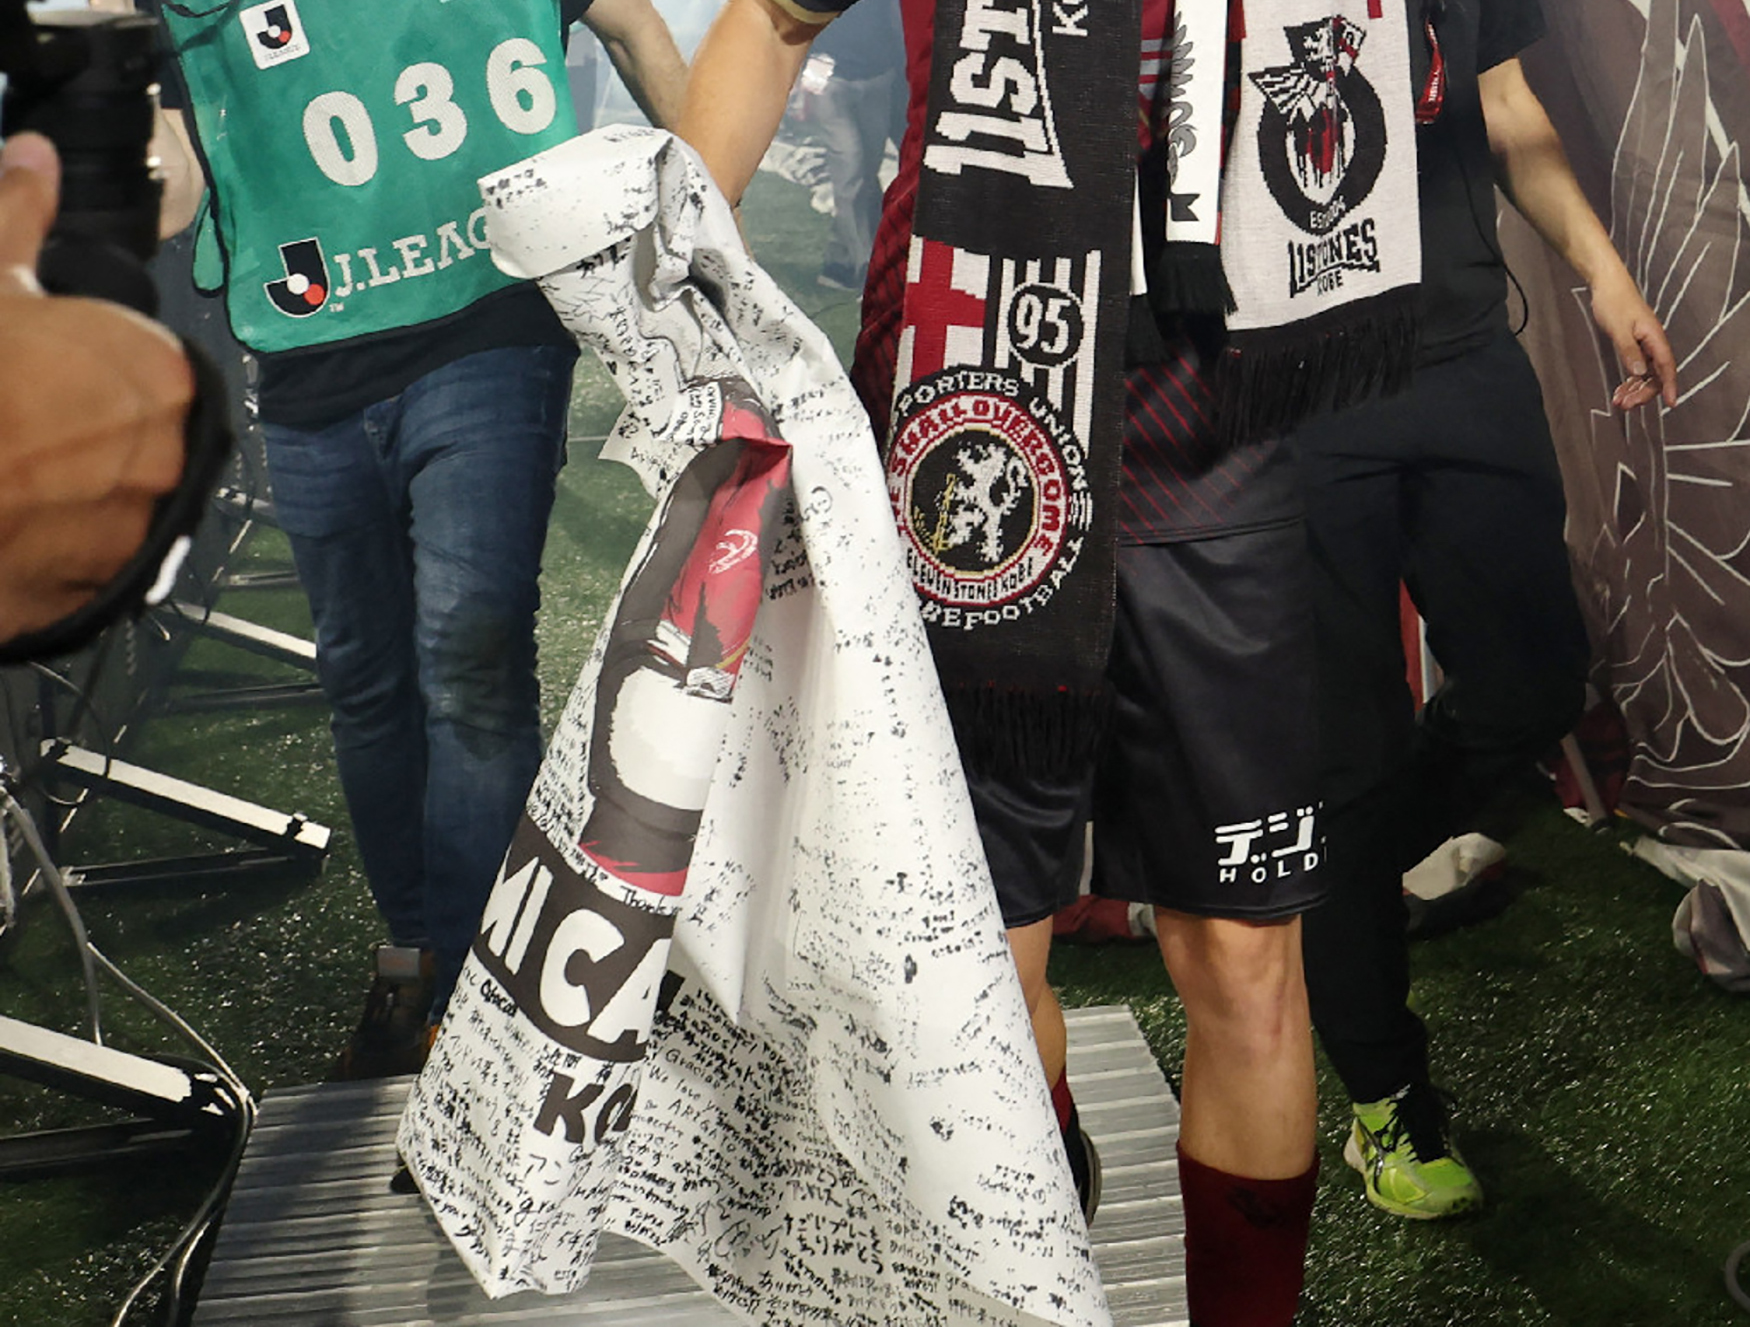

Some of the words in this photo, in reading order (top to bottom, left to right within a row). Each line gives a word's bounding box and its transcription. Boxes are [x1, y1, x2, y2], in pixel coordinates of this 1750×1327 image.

[333, 205, 492, 297] J.LEAG
[1016, 294, 1072, 354] 95
[898, 370, 1020, 417] PORTERS
